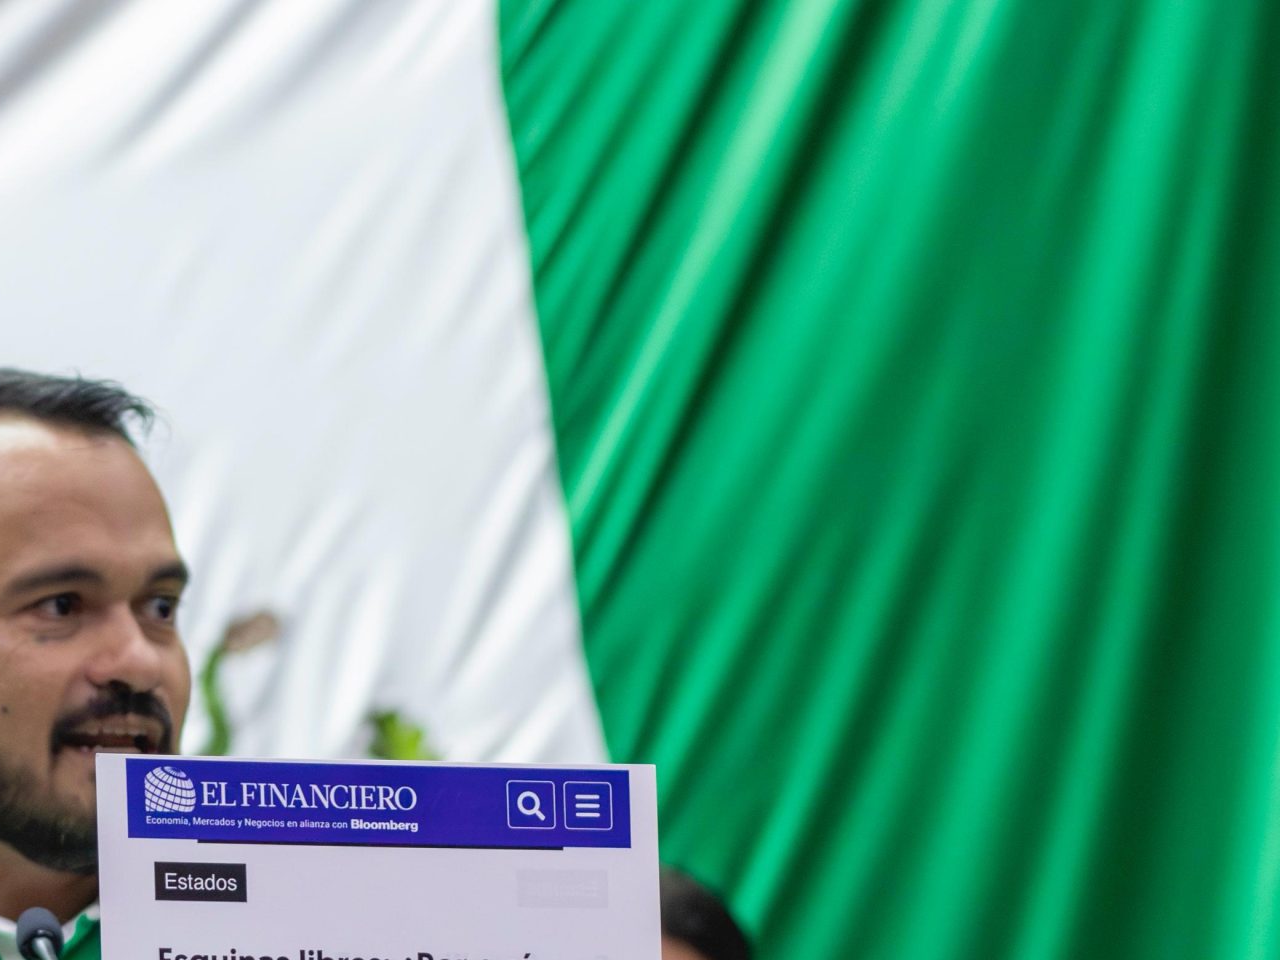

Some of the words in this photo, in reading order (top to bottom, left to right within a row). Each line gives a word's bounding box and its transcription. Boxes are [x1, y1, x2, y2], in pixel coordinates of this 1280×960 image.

[200, 781, 237, 807] EL
[240, 782, 417, 811] FINANCIERO
[192, 816, 236, 827] Mercados
[237, 819, 243, 829] y
[244, 817, 285, 829] Negocios
[286, 820, 298, 828] en
[299, 819, 331, 829] alianza
[331, 821, 348, 829] con
[350, 818, 419, 833] Bloomberg
[164, 872, 238, 892] Estados
